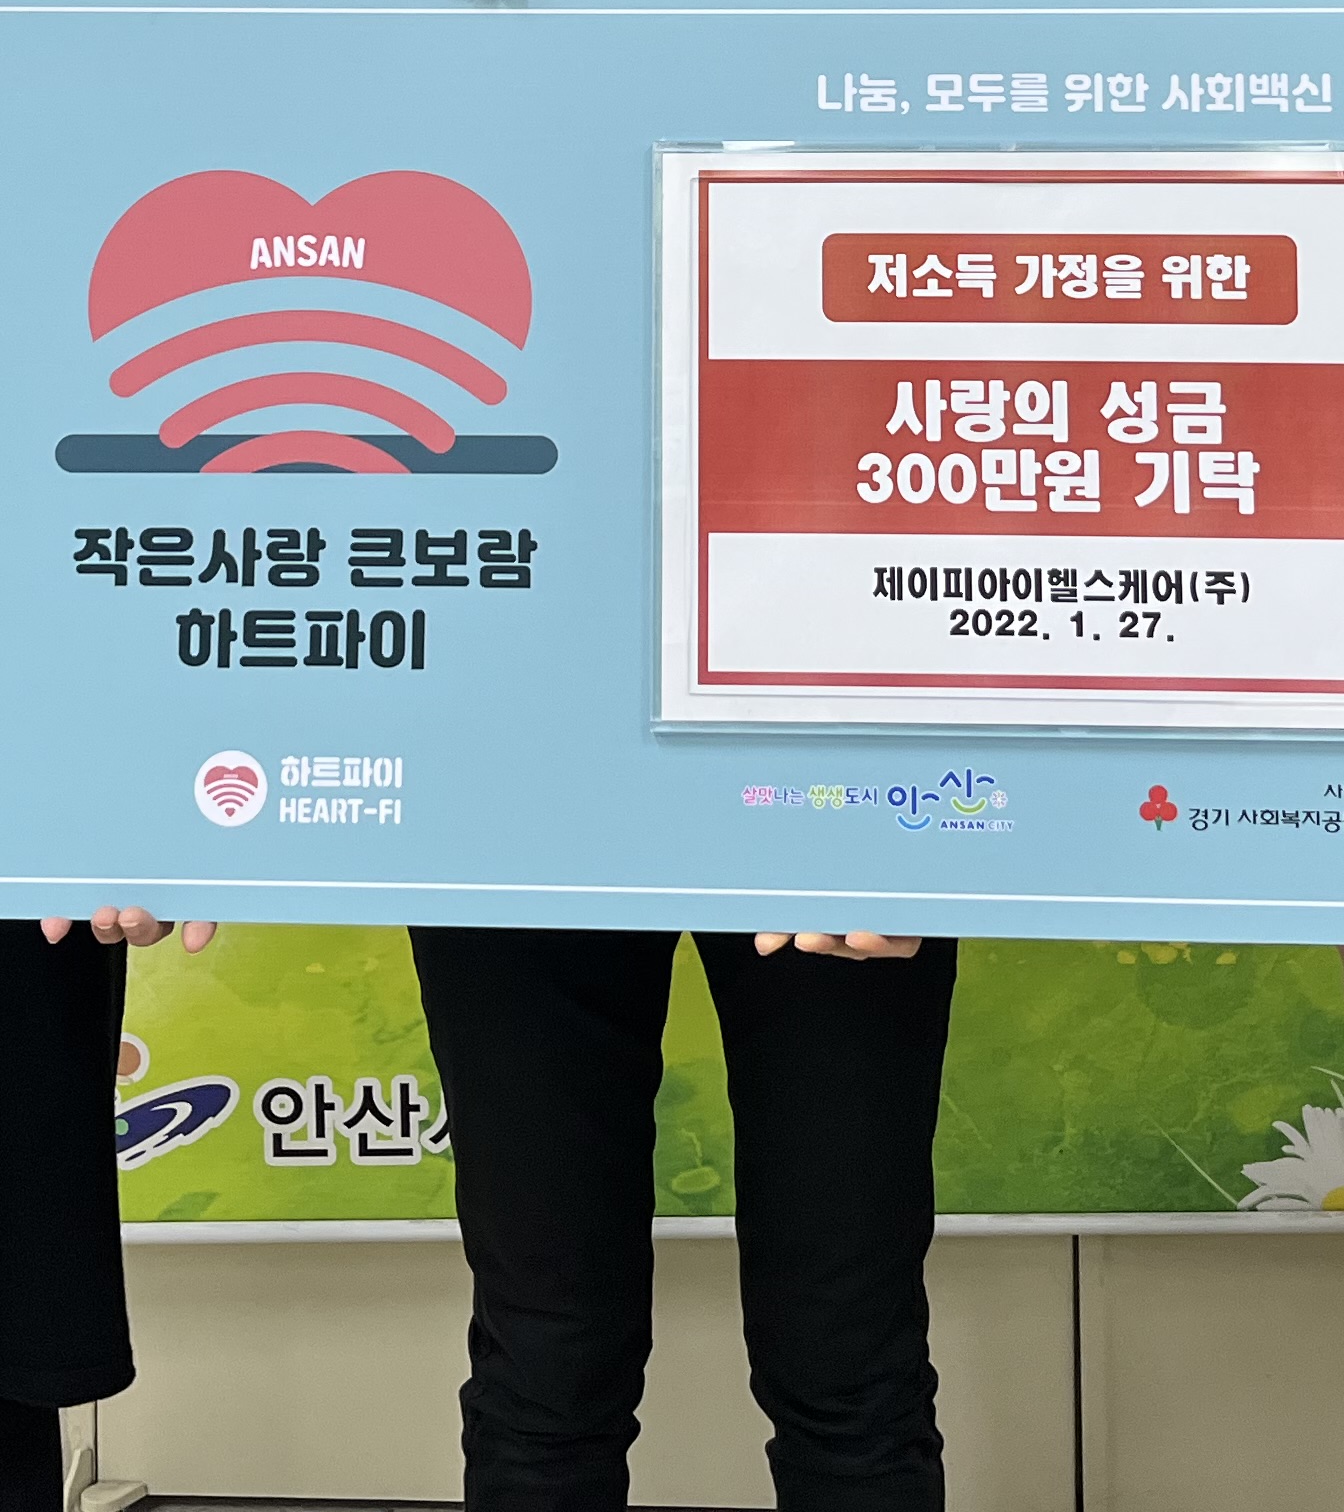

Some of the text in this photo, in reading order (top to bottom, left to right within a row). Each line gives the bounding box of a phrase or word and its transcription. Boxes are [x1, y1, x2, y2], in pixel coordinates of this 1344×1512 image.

[817, 72, 1333, 116] 나눔, 모두를 위한 사회백신
[250, 235, 366, 270] ANSAN
[867, 252, 1251, 300] 저소득 가정을 위한
[885, 379, 1227, 445] 사랑의 성금
[855, 448, 1261, 515] 300만원 기탁
[72, 526, 538, 589] 작은사랑 큰보람
[872, 566, 1250, 606] 제이피아이헬스케어(주)
[175, 607, 426, 670] 하트파이
[949, 608, 1175, 643] 2022. 1. 27.
[280, 755, 403, 789] 하트파이
[279, 797, 402, 825] HEART-FI
[742, 785, 804, 806] 살맛나는
[808, 785, 879, 809] 생생도시
[939, 819, 1015, 831] ANSAN CITY
[1188, 808, 1230, 832] 경기
